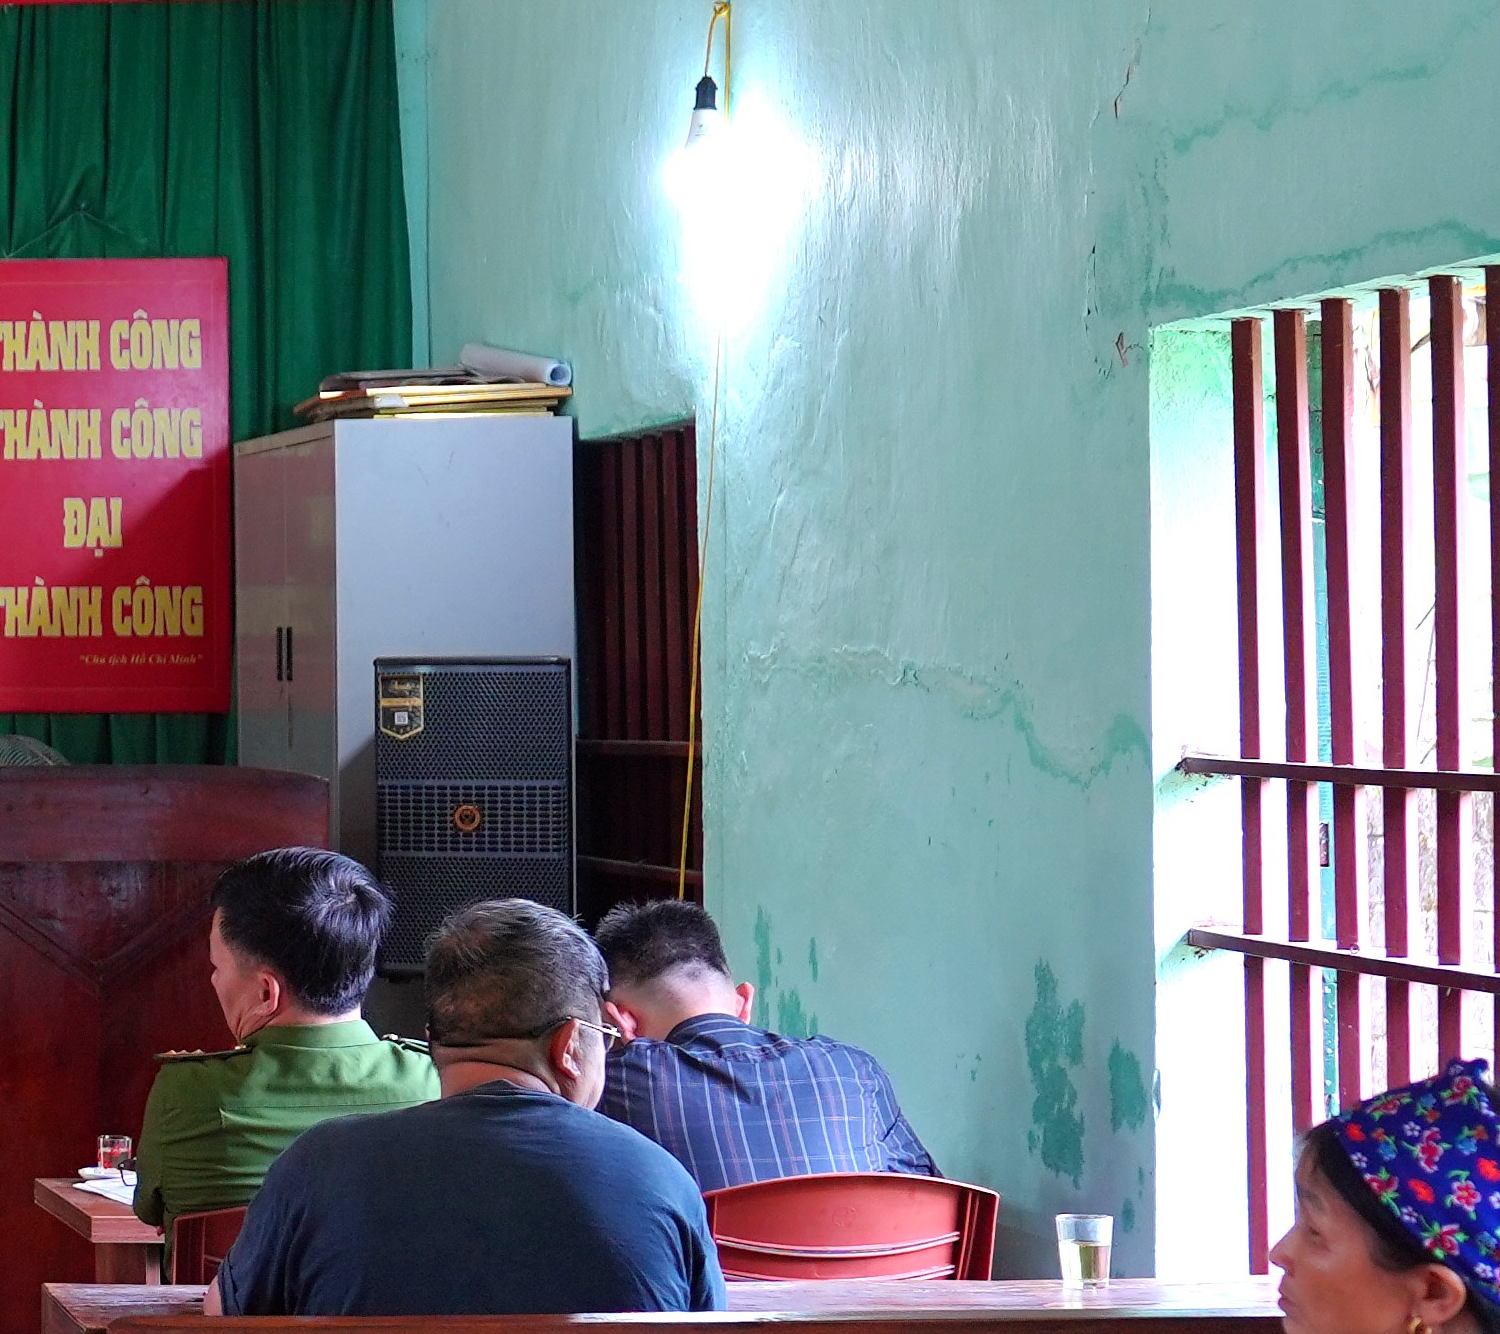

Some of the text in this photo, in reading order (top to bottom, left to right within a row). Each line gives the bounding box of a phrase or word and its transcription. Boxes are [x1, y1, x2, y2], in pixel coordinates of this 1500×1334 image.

[110, 308, 202, 371] CÔNG
[111, 397, 203, 459] CÔNG
[63, 497, 123, 558] ĐẠI
[112, 574, 204, 637] CÔNG
